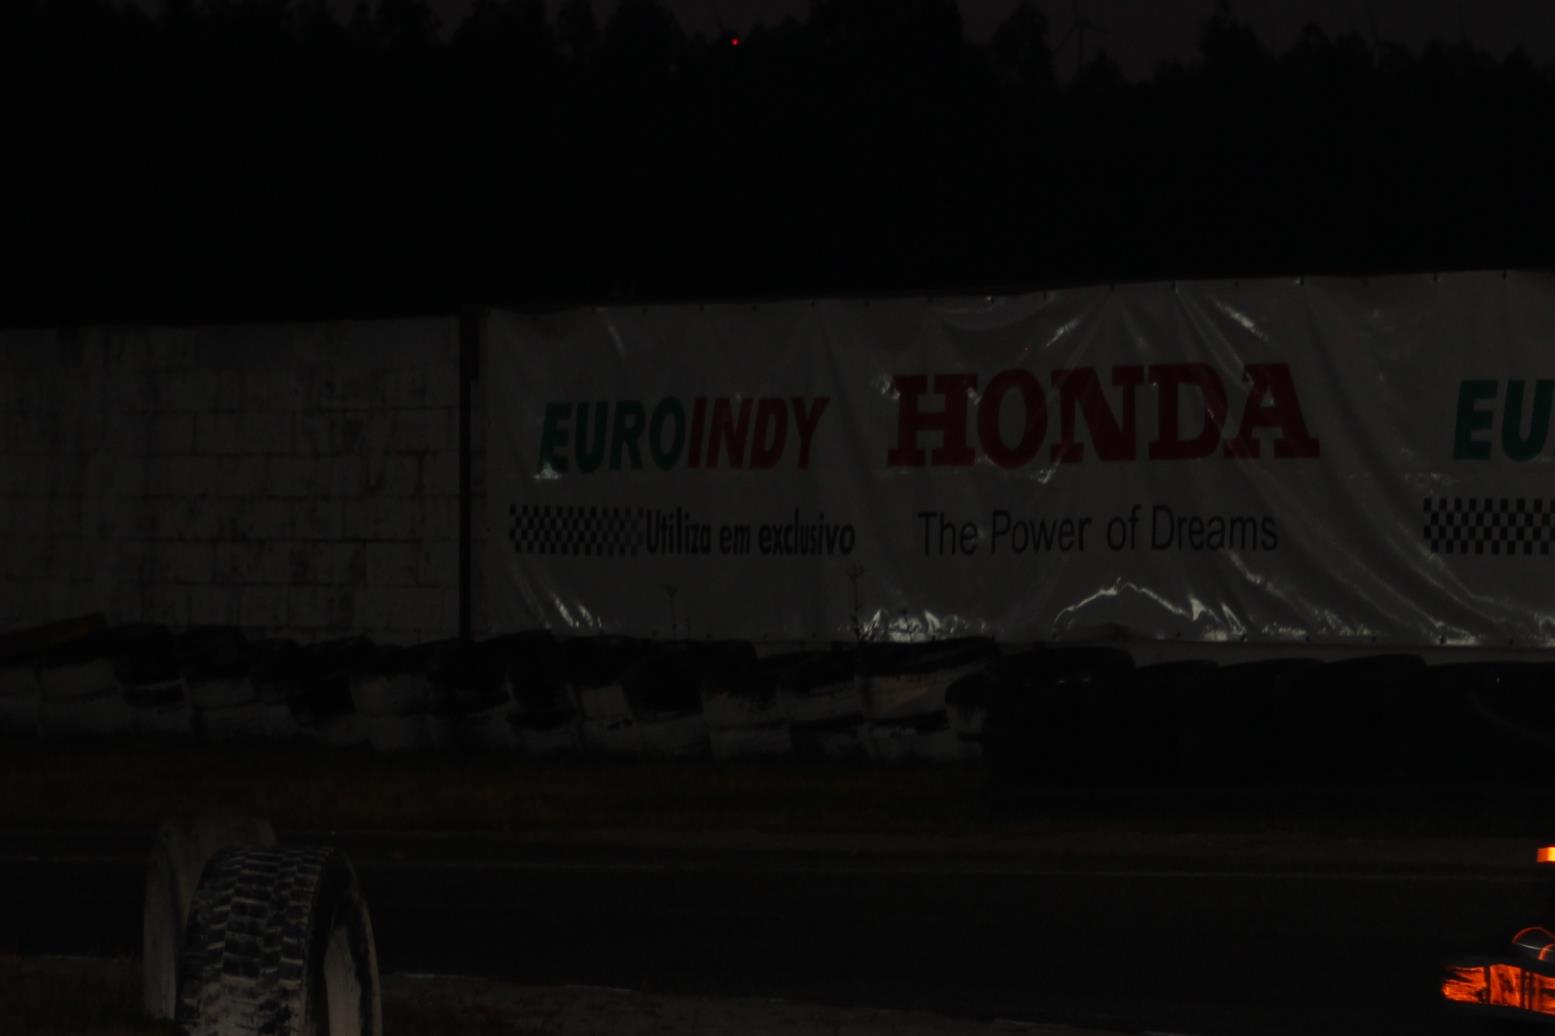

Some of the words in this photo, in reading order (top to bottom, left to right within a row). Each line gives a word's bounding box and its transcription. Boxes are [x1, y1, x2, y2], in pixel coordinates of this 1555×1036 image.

[538, 396, 830, 474] EUROINDY
[887, 362, 1321, 468] HONDA
[645, 506, 711, 554] Utiliza
[719, 523, 751, 554] em
[758, 508, 857, 555] exclusivo
[918, 510, 979, 556] The
[991, 509, 1091, 554] Power
[1106, 504, 1141, 552] of
[1151, 504, 1279, 552] Dreams
